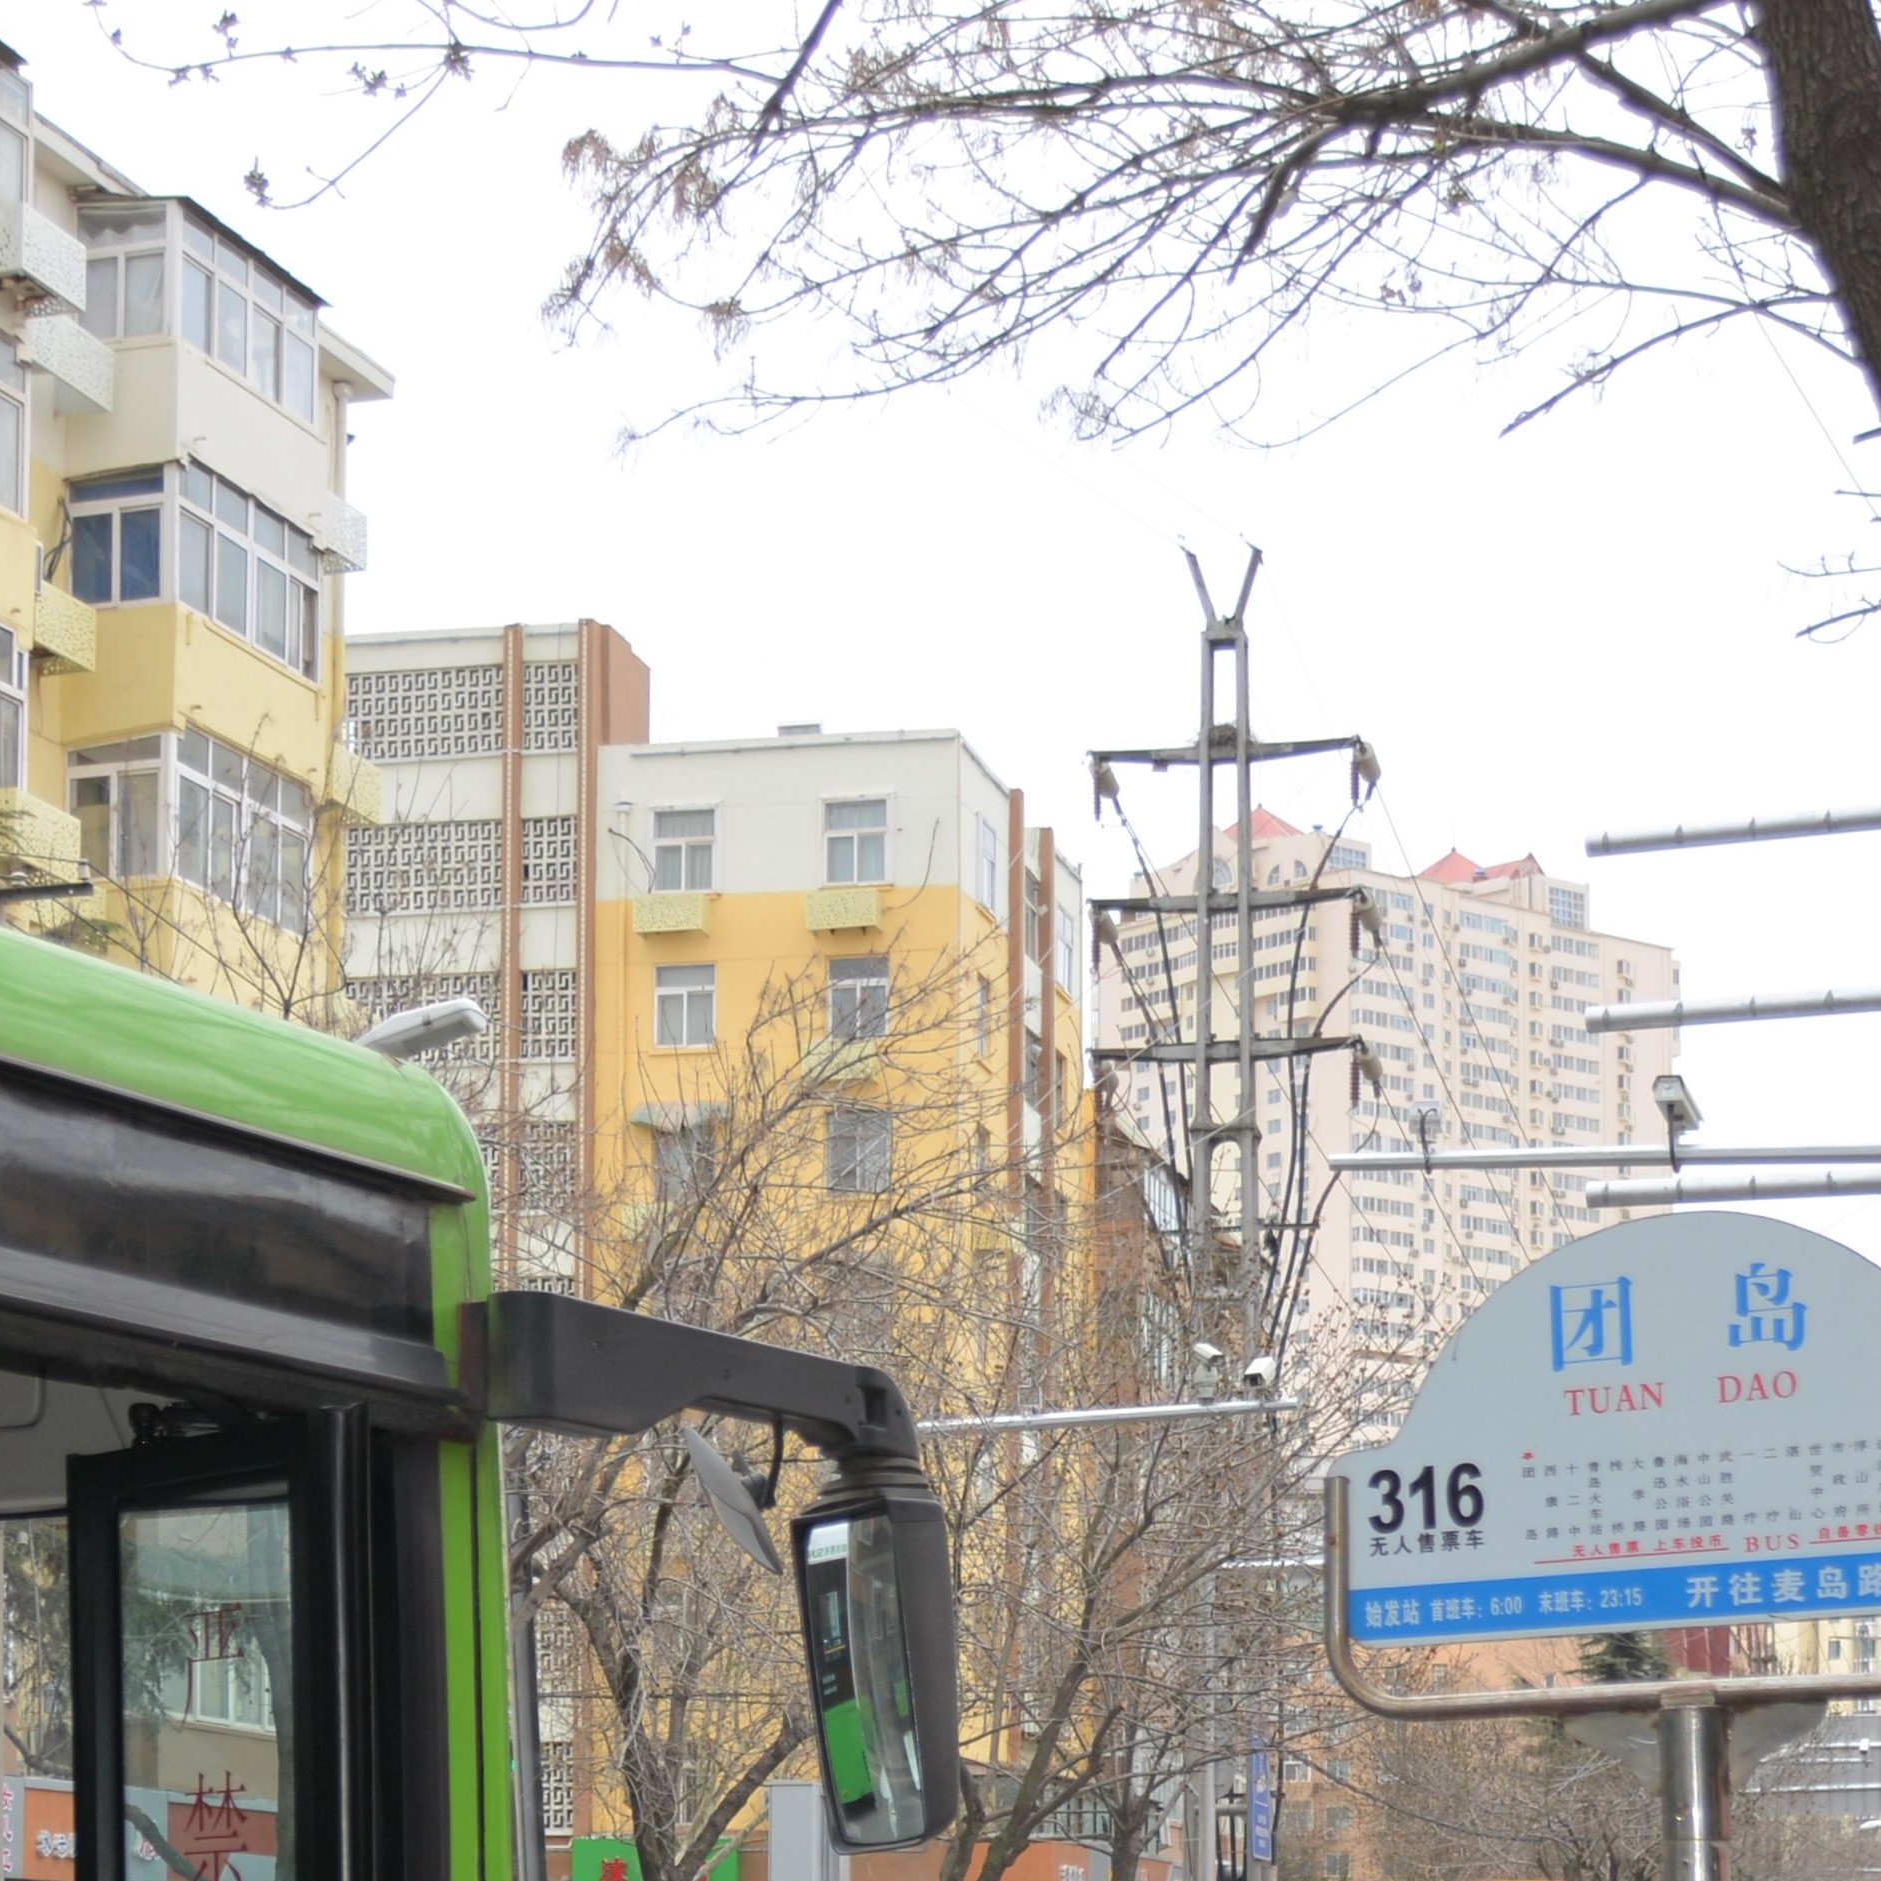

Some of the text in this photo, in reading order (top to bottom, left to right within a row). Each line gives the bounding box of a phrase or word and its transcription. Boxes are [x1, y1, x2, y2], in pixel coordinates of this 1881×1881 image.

[1549, 1261, 1806, 1371] 团岛
[1563, 1370, 1799, 1417] TUAN DAO
[1368, 1462, 1484, 1534] 316
[1588, 1461, 1603, 1535] 青岛火车站
[1632, 1458, 1647, 1532] 大学路
[1654, 1456, 1669, 1531] 鲁迅公园
[1674, 1454, 1691, 1529] 海水浴场
[1697, 1452, 1713, 1528] 中山公园
[1370, 1529, 1484, 1557] 无人售票车
[1573, 1540, 1640, 1557] 无人售票
[1654, 1534, 1722, 1552] 上车投币
[1745, 1533, 1800, 1552] BUS
[1365, 1599, 1420, 1628] 始发站
